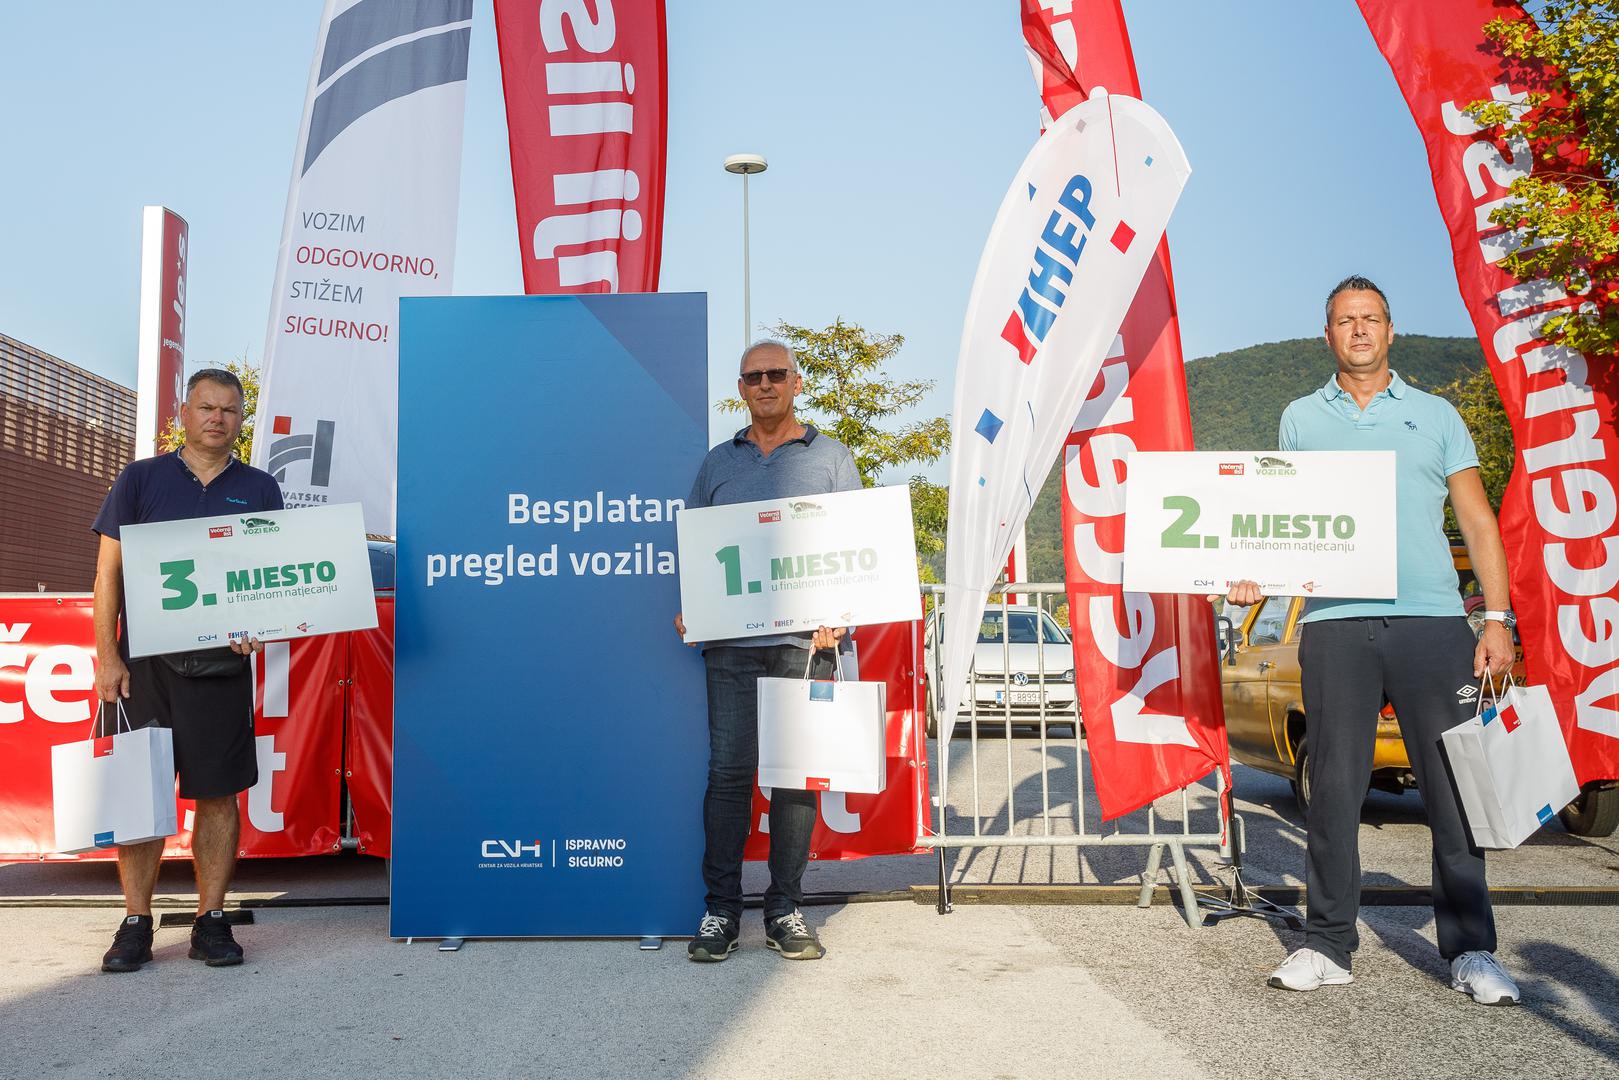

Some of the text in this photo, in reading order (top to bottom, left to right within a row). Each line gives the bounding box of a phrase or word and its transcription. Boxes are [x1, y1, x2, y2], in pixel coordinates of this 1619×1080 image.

[301, 211, 365, 233] VOZIM
[1026, 173, 1097, 309] HEP
[295, 246, 439, 280] ODGOVORNO,
[290, 278, 363, 304] STIŽEM
[284, 315, 389, 343] SIGURNO!
[508, 490, 686, 533] Besplatan
[1161, 495, 1355, 549] 2. MJESTO
[1230, 539, 1355, 554] u finalnom natjecanju
[426, 542, 676, 587] pregled vozila
[715, 545, 878, 596] 1. MJESTO
[160, 559, 336, 611] 3. MJESTO
[227, 584, 338, 604] u finalnom natjecanju
[771, 574, 880, 592] u finalnom natjecanju
[565, 839, 627, 851] ISPRAVNO
[568, 855, 625, 867] SIGURNO
